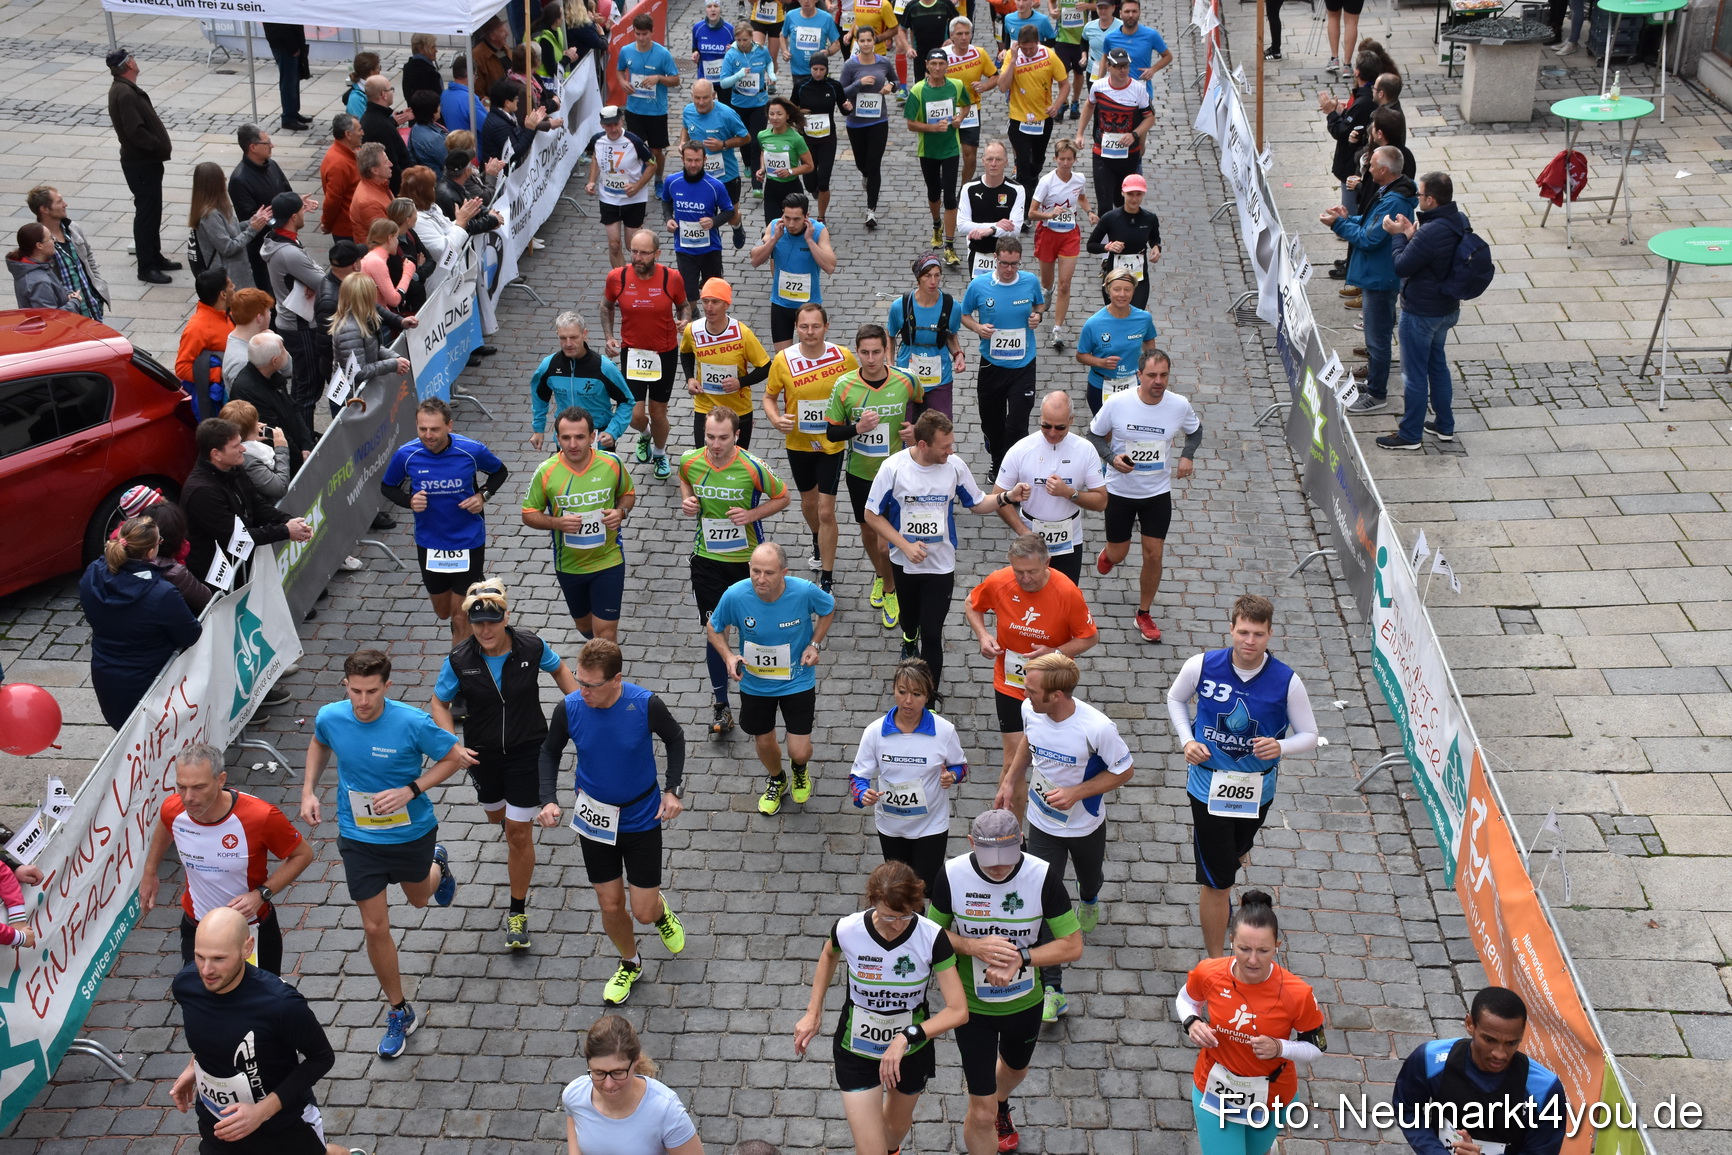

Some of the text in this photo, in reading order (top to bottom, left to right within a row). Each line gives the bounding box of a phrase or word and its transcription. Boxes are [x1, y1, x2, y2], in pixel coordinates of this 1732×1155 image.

[198, 0, 217, 10] frei
[220, 3, 234, 11] zu
[236, 3, 266, 12] sein.
[1064, 12, 1081, 21] 2749
[800, 33, 817, 43] 2773
[701, 43, 724, 51] SYSCAD
[947, 59, 982, 75] MAX BÖGL
[1016, 60, 1051, 75] MAX BÖGL
[738, 80, 756, 88] 2004
[859, 100, 878, 109] 2087
[930, 108, 949, 118] 2571
[810, 121, 823, 130] 127
[768, 159, 787, 169] 2023
[676, 200, 705, 210] SYSCAD
[683, 229, 705, 239] 2465
[444, 248, 454, 266] swn
[1299, 259, 1310, 280] swn
[785, 282, 803, 291] 272
[1012, 298, 1030, 306] BOCK
[995, 338, 1021, 349] 2740
[696, 343, 744, 358] MAX BÖGL
[635, 358, 653, 369] 137
[793, 364, 848, 389] MAX BÖGL
[918, 366, 932, 376] 23
[332, 381, 345, 399] swn
[1341, 384, 1356, 402] swn
[1138, 425, 1164, 434] BOSCHEL
[1131, 450, 1159, 462] 2224
[420, 478, 463, 490] SYSCAD
[555, 487, 611, 508] BOCK
[694, 484, 745, 501] BOCK
[709, 528, 740, 540] 2772
[907, 522, 938, 535] 2083
[215, 561, 227, 583] swn
[779, 618, 801, 629] BOCK
[1008, 622, 1045, 635] funrunners
[1018, 630, 1050, 641] neumarkt
[754, 655, 778, 667] 131
[1200, 679, 1233, 703] 33
[893, 755, 927, 764] BOSCHEL
[1038, 748, 1075, 763] BOSCHEL
[885, 789, 919, 807] 2424
[1216, 784, 1254, 800] 2085
[1223, 802, 1243, 810] Jürgen
[579, 803, 611, 829] 2585
[16, 827, 41, 855] swn
[965, 908, 991, 917] OBI
[963, 923, 1031, 938] Laufteam
[81, 916, 130, 1001] Service-Line:
[128, 905, 136, 919] 0
[1511, 937, 1520, 953] für
[1517, 952, 1526, 968] die
[857, 971, 883, 981] OBI
[1521, 932, 1545, 981] Neumarkts
[1540, 979, 1563, 1020] moderner
[853, 984, 922, 999] Laufteam
[989, 985, 1021, 995] Karl-Heinz
[867, 998, 908, 1009] Fürth
[860, 1023, 903, 1042] 2005
[200, 1081, 240, 1105] 2461
